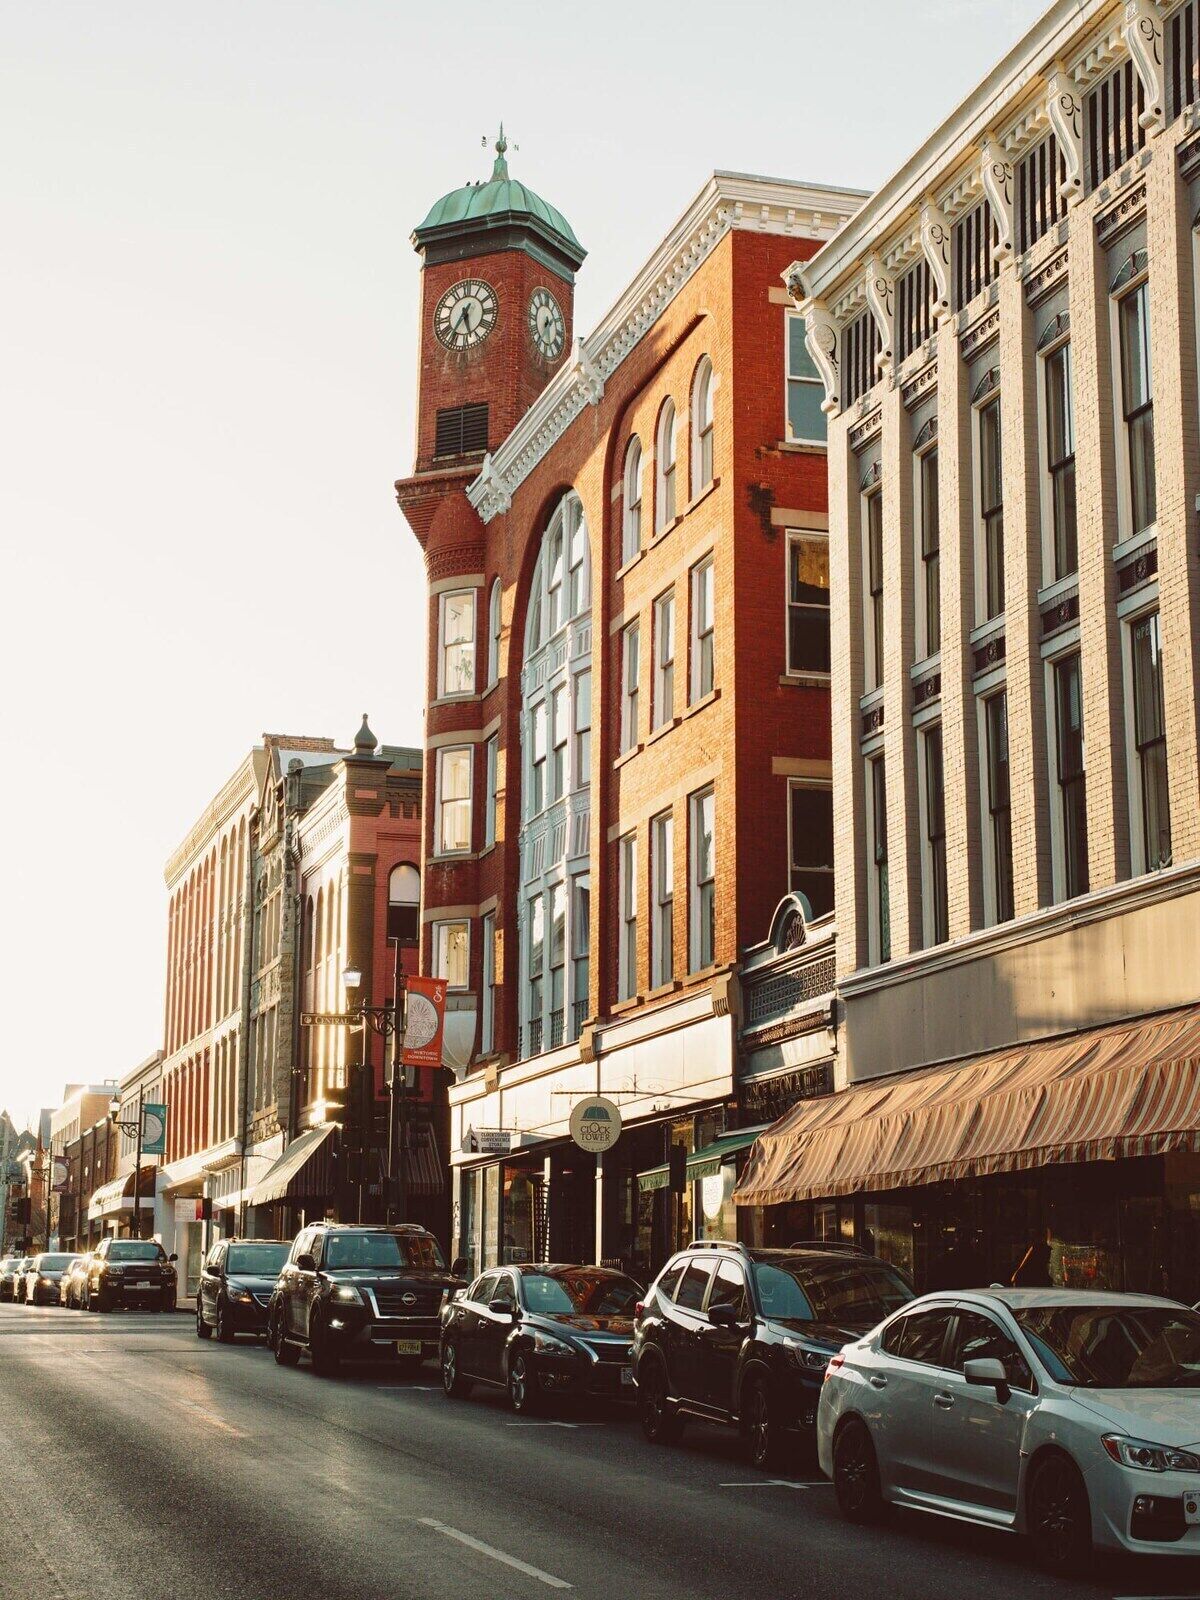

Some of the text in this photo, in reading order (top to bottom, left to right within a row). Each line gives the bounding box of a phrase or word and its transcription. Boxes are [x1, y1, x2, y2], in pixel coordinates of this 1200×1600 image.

[315, 1016, 349, 1025] CENTRAL
[580, 1122, 611, 1134] CLOCK
[580, 1133, 610, 1141] TOWER
